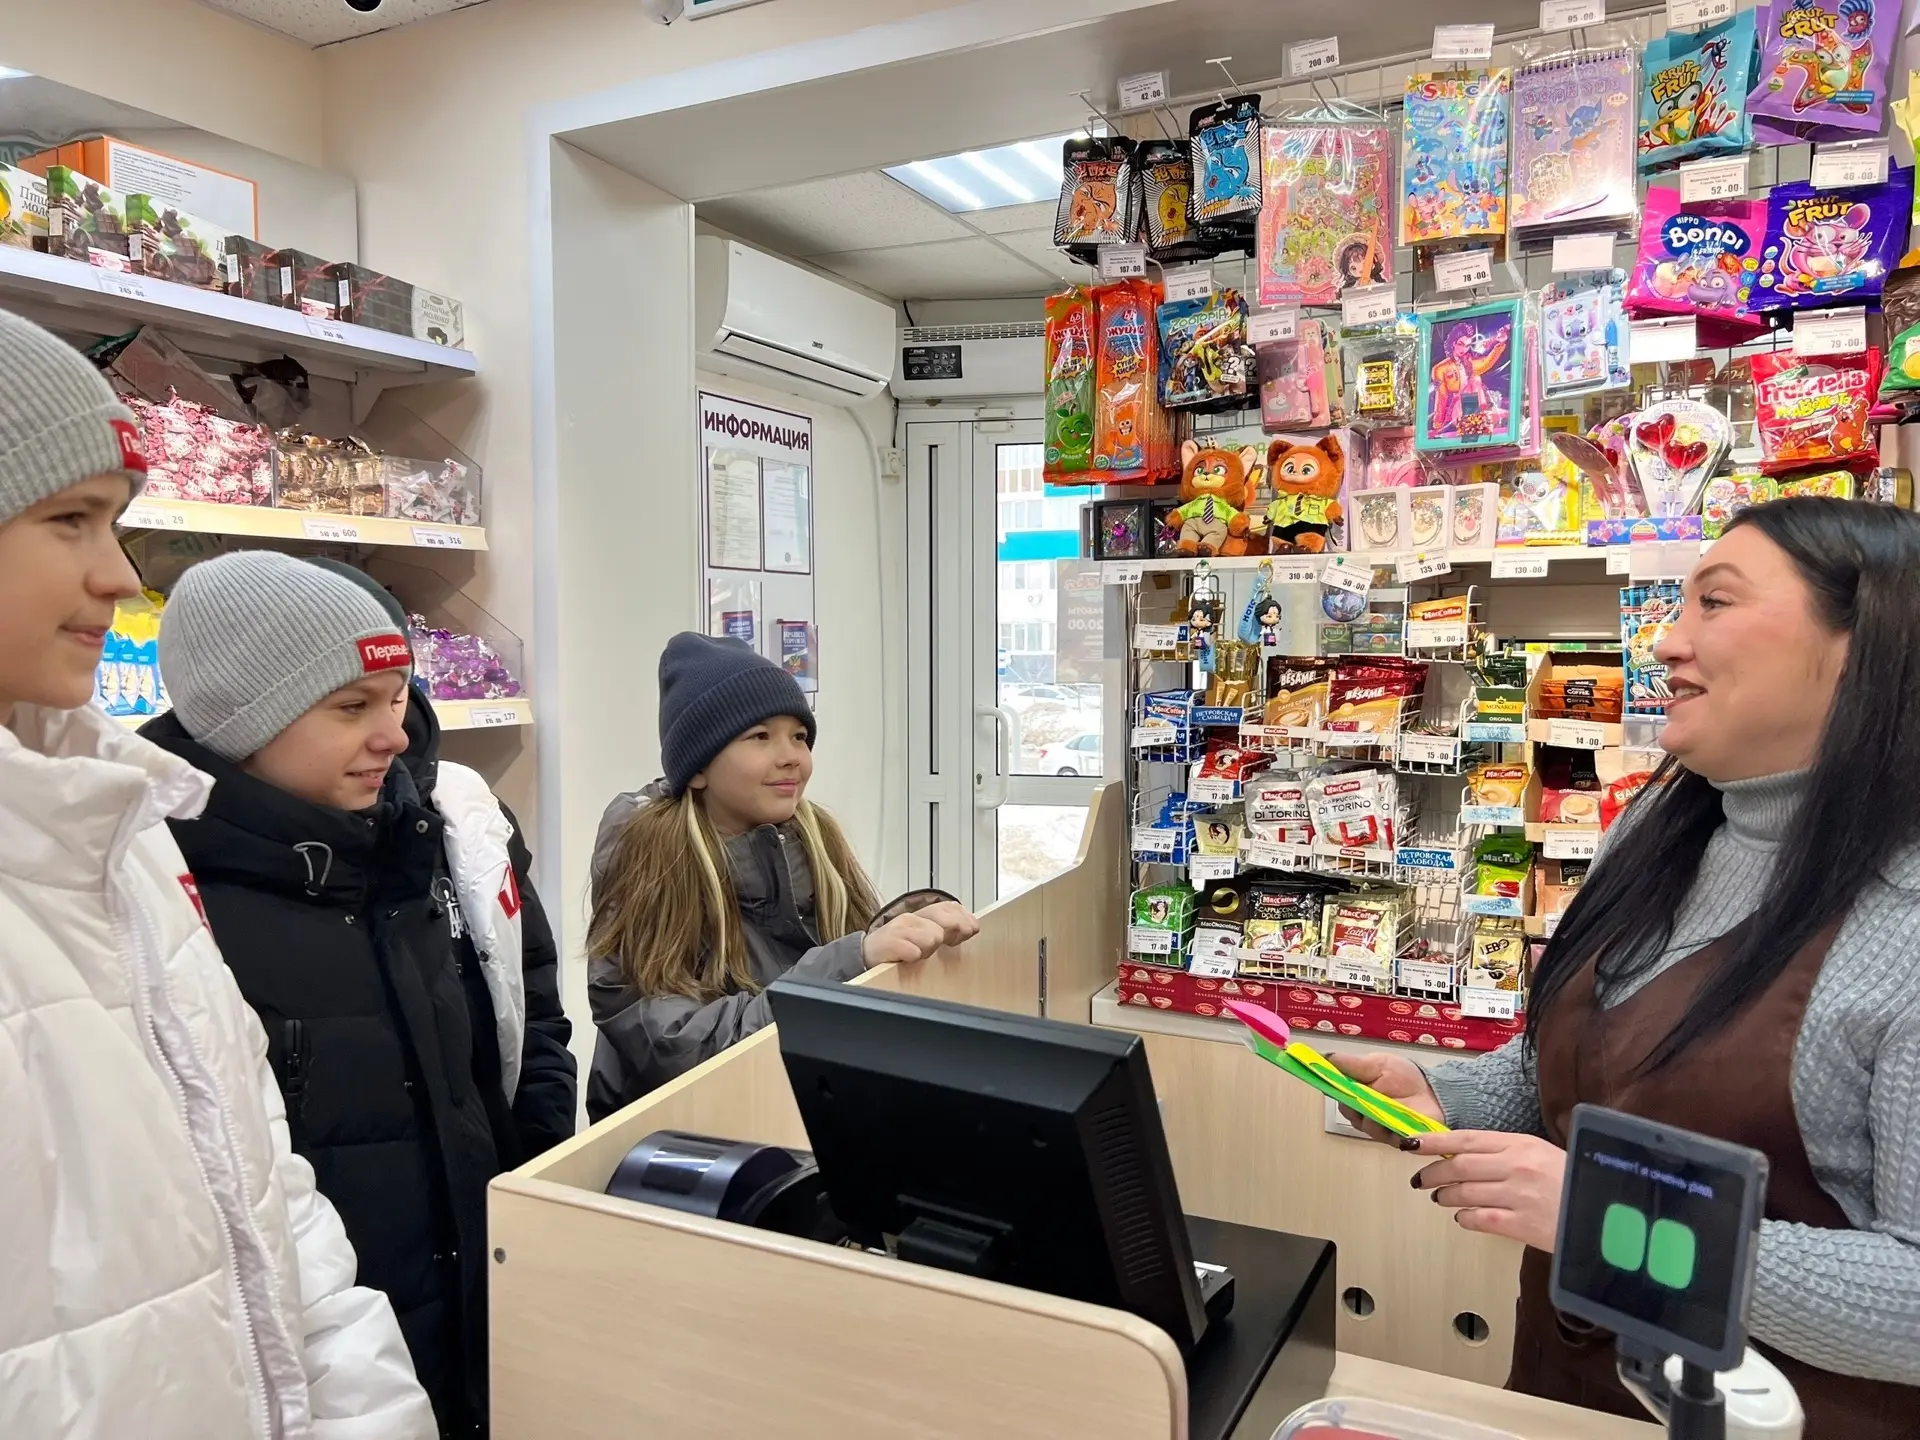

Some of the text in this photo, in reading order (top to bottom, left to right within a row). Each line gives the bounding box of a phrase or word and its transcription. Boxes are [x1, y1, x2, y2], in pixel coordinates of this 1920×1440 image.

[1786, 7, 1824, 24] KRUT
[1657, 60, 1694, 82] KRUT
[1651, 65, 1702, 104] FRUT
[1796, 194, 1840, 208] KRUT
[1788, 202, 1854, 228] FRUT
[1676, 216, 1700, 225] HIPPO
[1171, 308, 1228, 332] ZOOTOPIA
[704, 410, 809, 450] ИНФОРМАЦИЯ
[172, 515, 184, 525] 29
[342, 528, 357, 538] 600
[448, 536, 462, 544] 316
[1424, 608, 1461, 619] MacCoffee
[1154, 705, 1186, 715] MacCoffee
[1196, 710, 1238, 718] ПЕТРОВСКАЯ
[504, 712, 516, 721] 177
[1486, 770, 1523, 778] MacCoffee
[1326, 782, 1360, 795] MacCoffee
[1264, 792, 1300, 800] MacCoffee
[1319, 800, 1371, 814] DI TORINO
[1255, 810, 1310, 819] DI TORINO
[1405, 858, 1445, 867] СЛОБОДА
[1483, 853, 1520, 864] MacTea
[1263, 896, 1297, 904] MacCoffee
